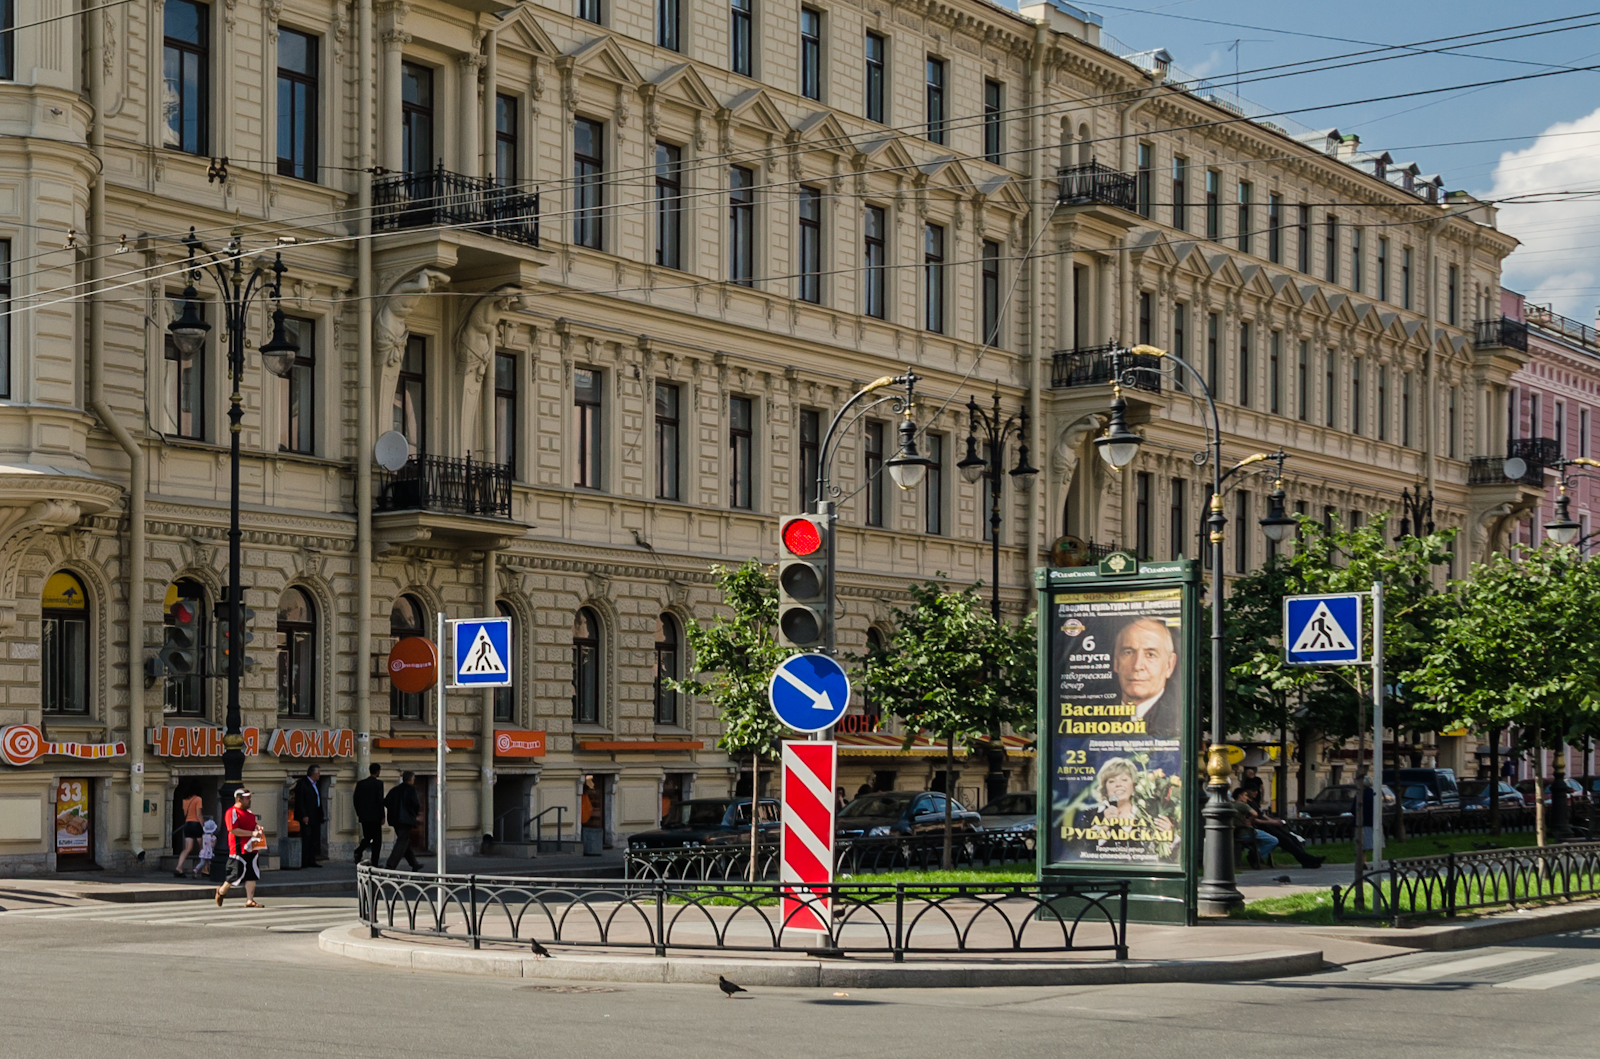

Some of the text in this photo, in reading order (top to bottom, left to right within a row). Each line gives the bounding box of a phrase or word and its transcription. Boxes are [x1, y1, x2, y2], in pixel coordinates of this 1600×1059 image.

[1082, 635, 1096, 652] 6
[1069, 653, 1111, 663] августа
[1060, 701, 1136, 716] Василий
[1058, 718, 1146, 734] Лановой
[153, 726, 354, 757] ЧАЙНЯ ЛОЖКА
[1066, 750, 1087, 764] 23
[1057, 766, 1096, 774] АВГУСТА
[1091, 815, 1148, 827] ЛАРИСА
[1060, 826, 1174, 841] РУБАЛЬСКАЯ
